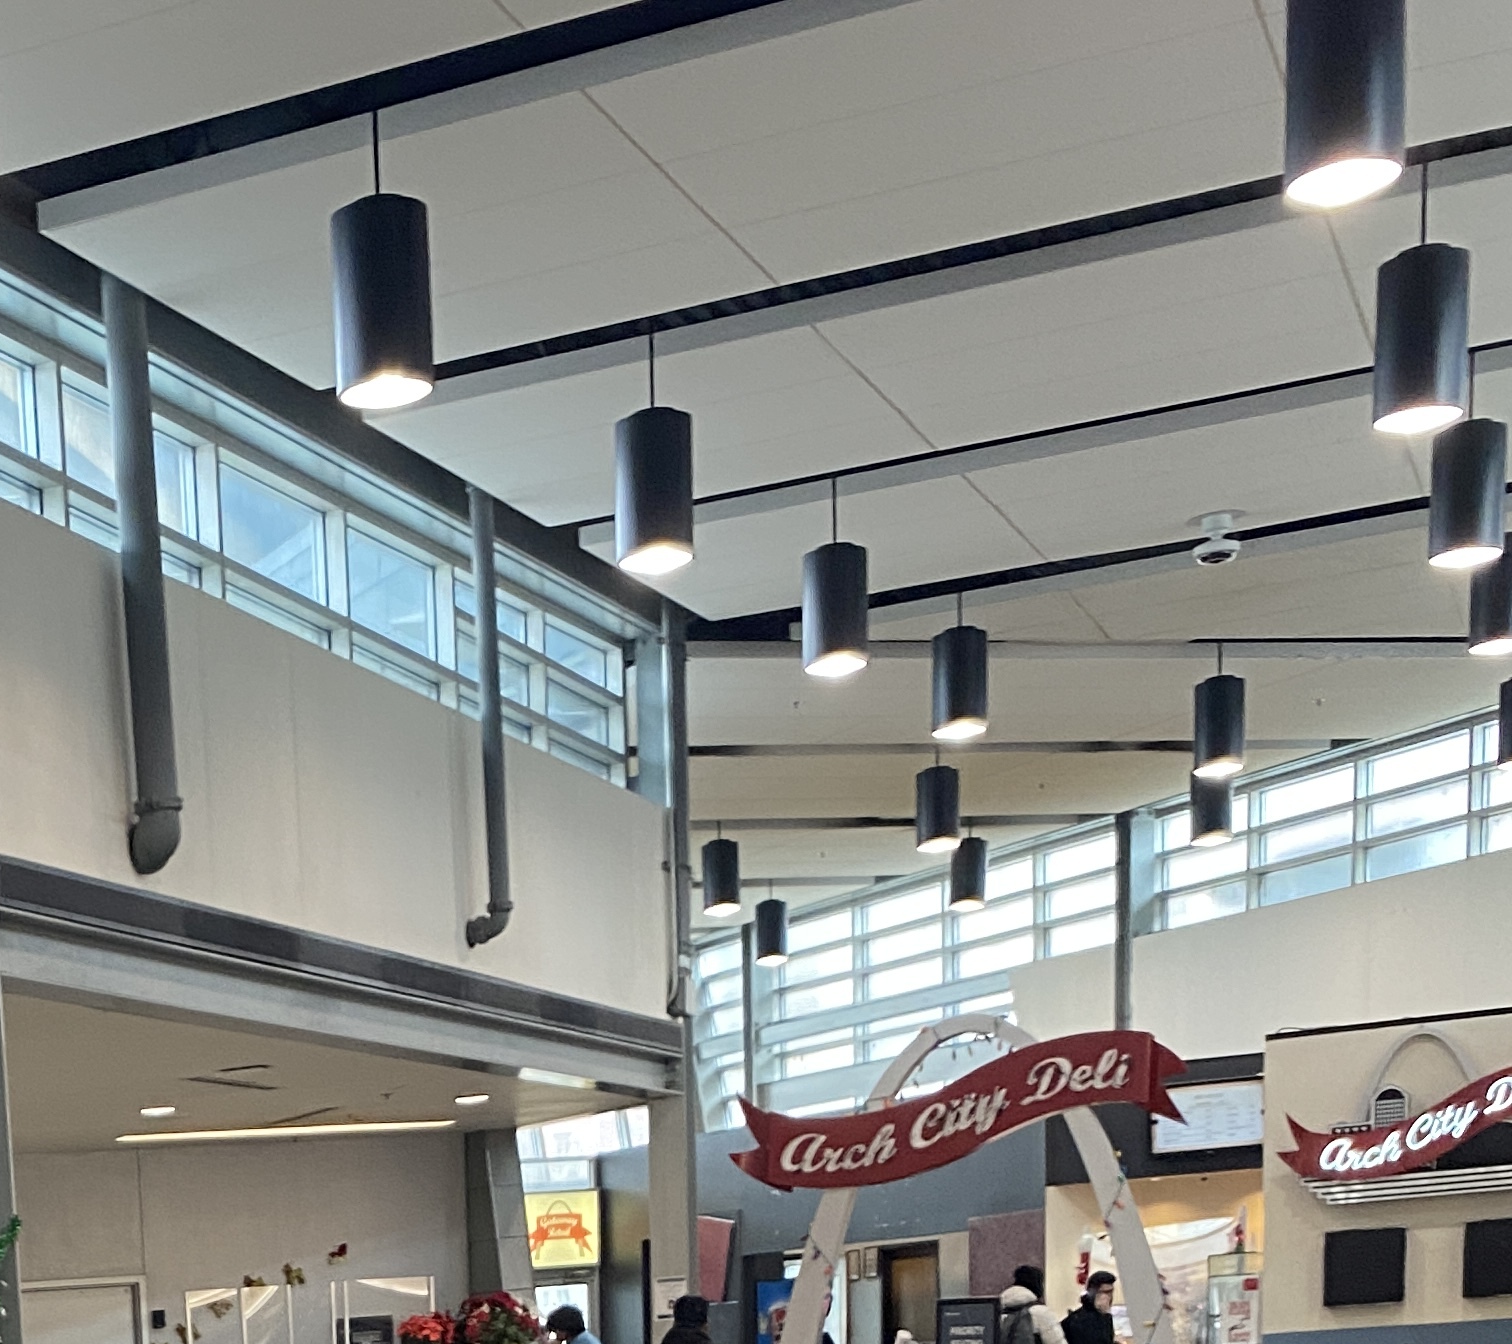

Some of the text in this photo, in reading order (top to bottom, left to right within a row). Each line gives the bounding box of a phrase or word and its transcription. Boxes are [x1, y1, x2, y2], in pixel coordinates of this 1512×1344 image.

[779, 1048, 1132, 1174] Arch City Deli
[1318, 1129, 1403, 1172] Arch
[1405, 1100, 1479, 1150] City
